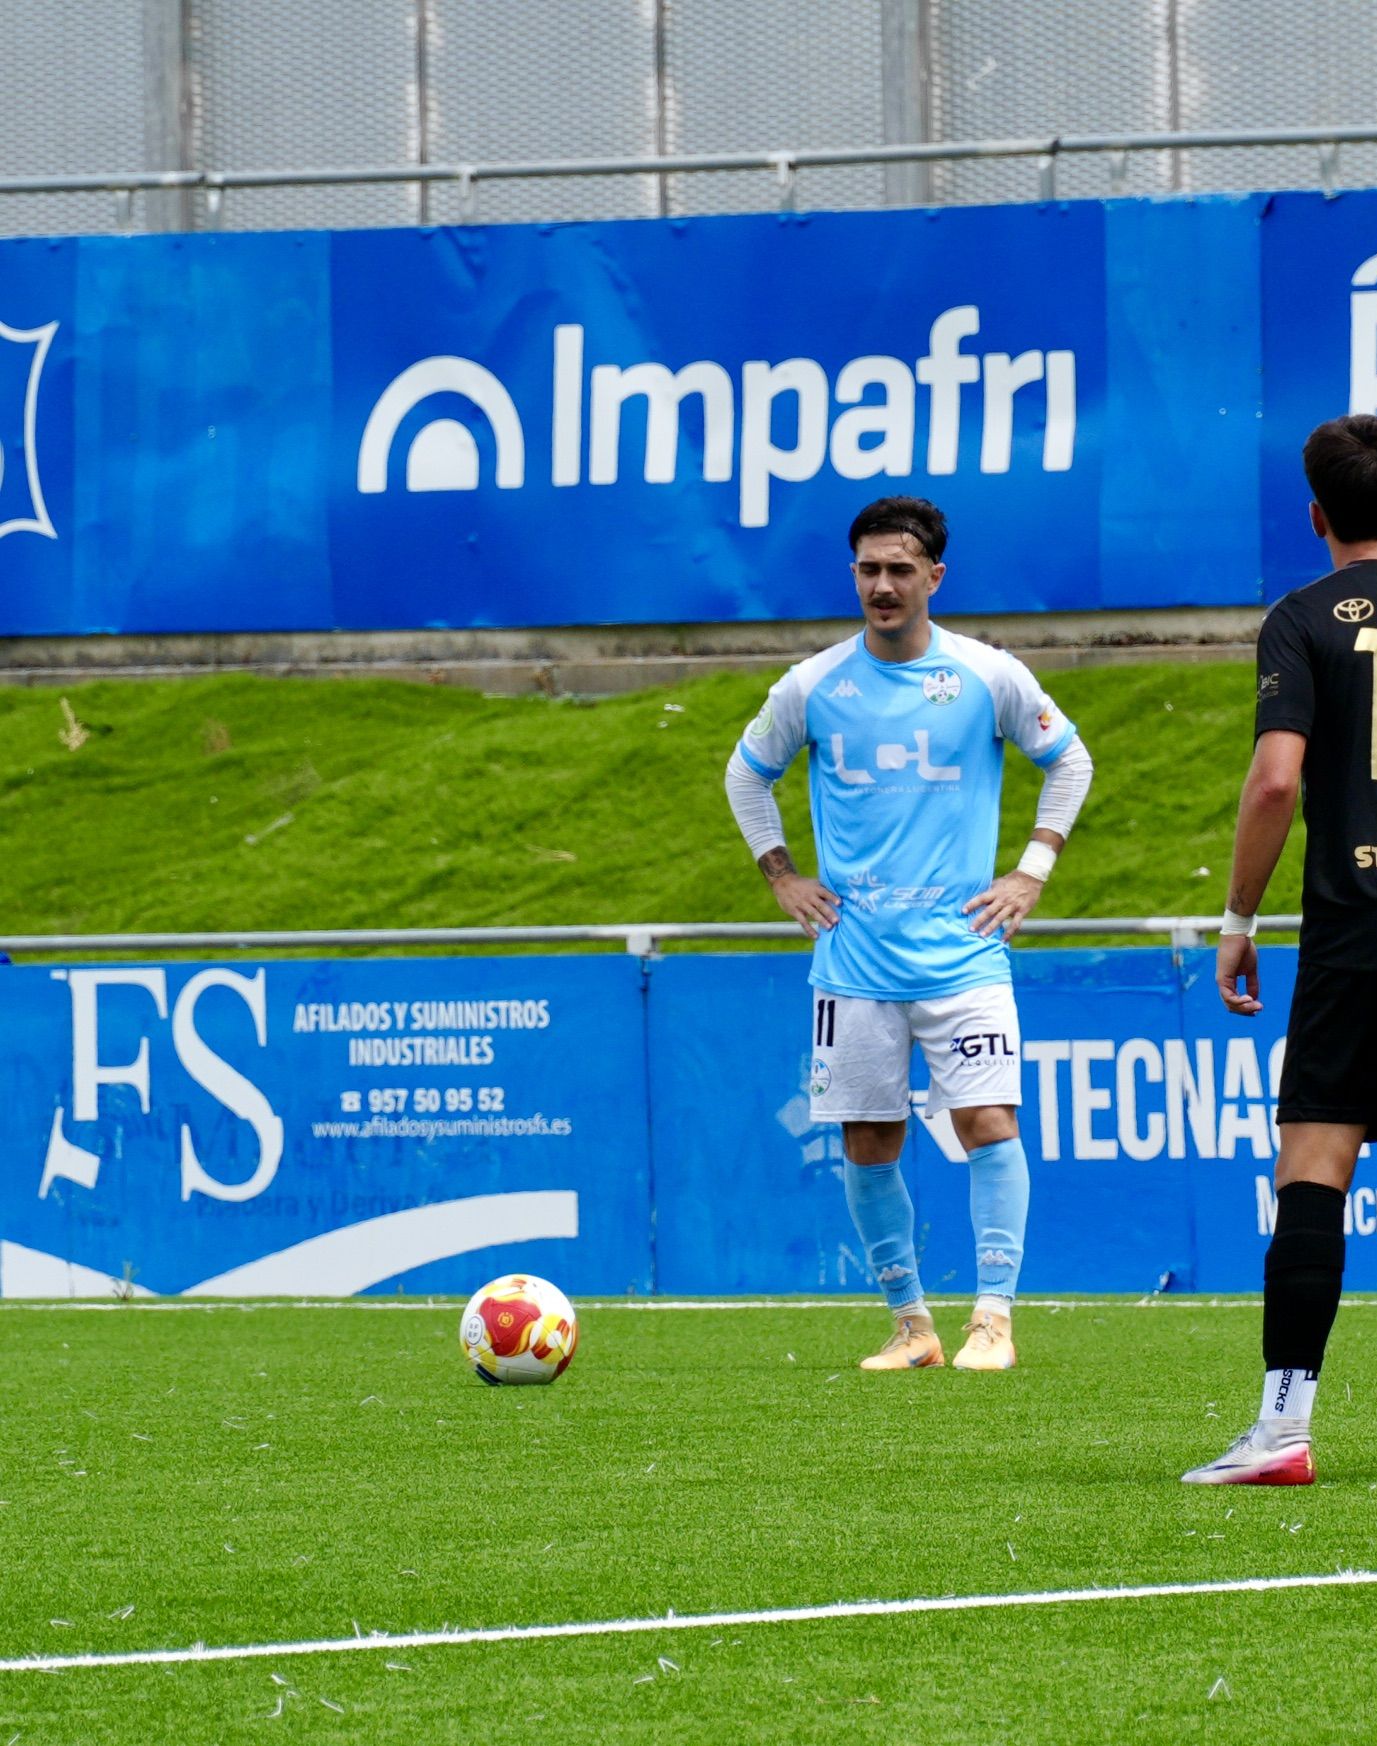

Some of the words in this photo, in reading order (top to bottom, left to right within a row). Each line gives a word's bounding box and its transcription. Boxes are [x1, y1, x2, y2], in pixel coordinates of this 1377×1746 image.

[552, 305, 1075, 528] Impafri
[293, 1002, 392, 1033] AFILADOS
[393, 1002, 408, 1031] Y
[410, 999, 551, 1031] SUMINISTROS
[816, 999, 835, 1048] 11
[348, 1035, 495, 1067] INDUSTRIALES
[367, 1088, 409, 1113] 957
[413, 1087, 441, 1112] 50
[444, 1087, 473, 1112] 95
[477, 1086, 505, 1111] 52
[1275, 1369, 1293, 1413] SOCKS
